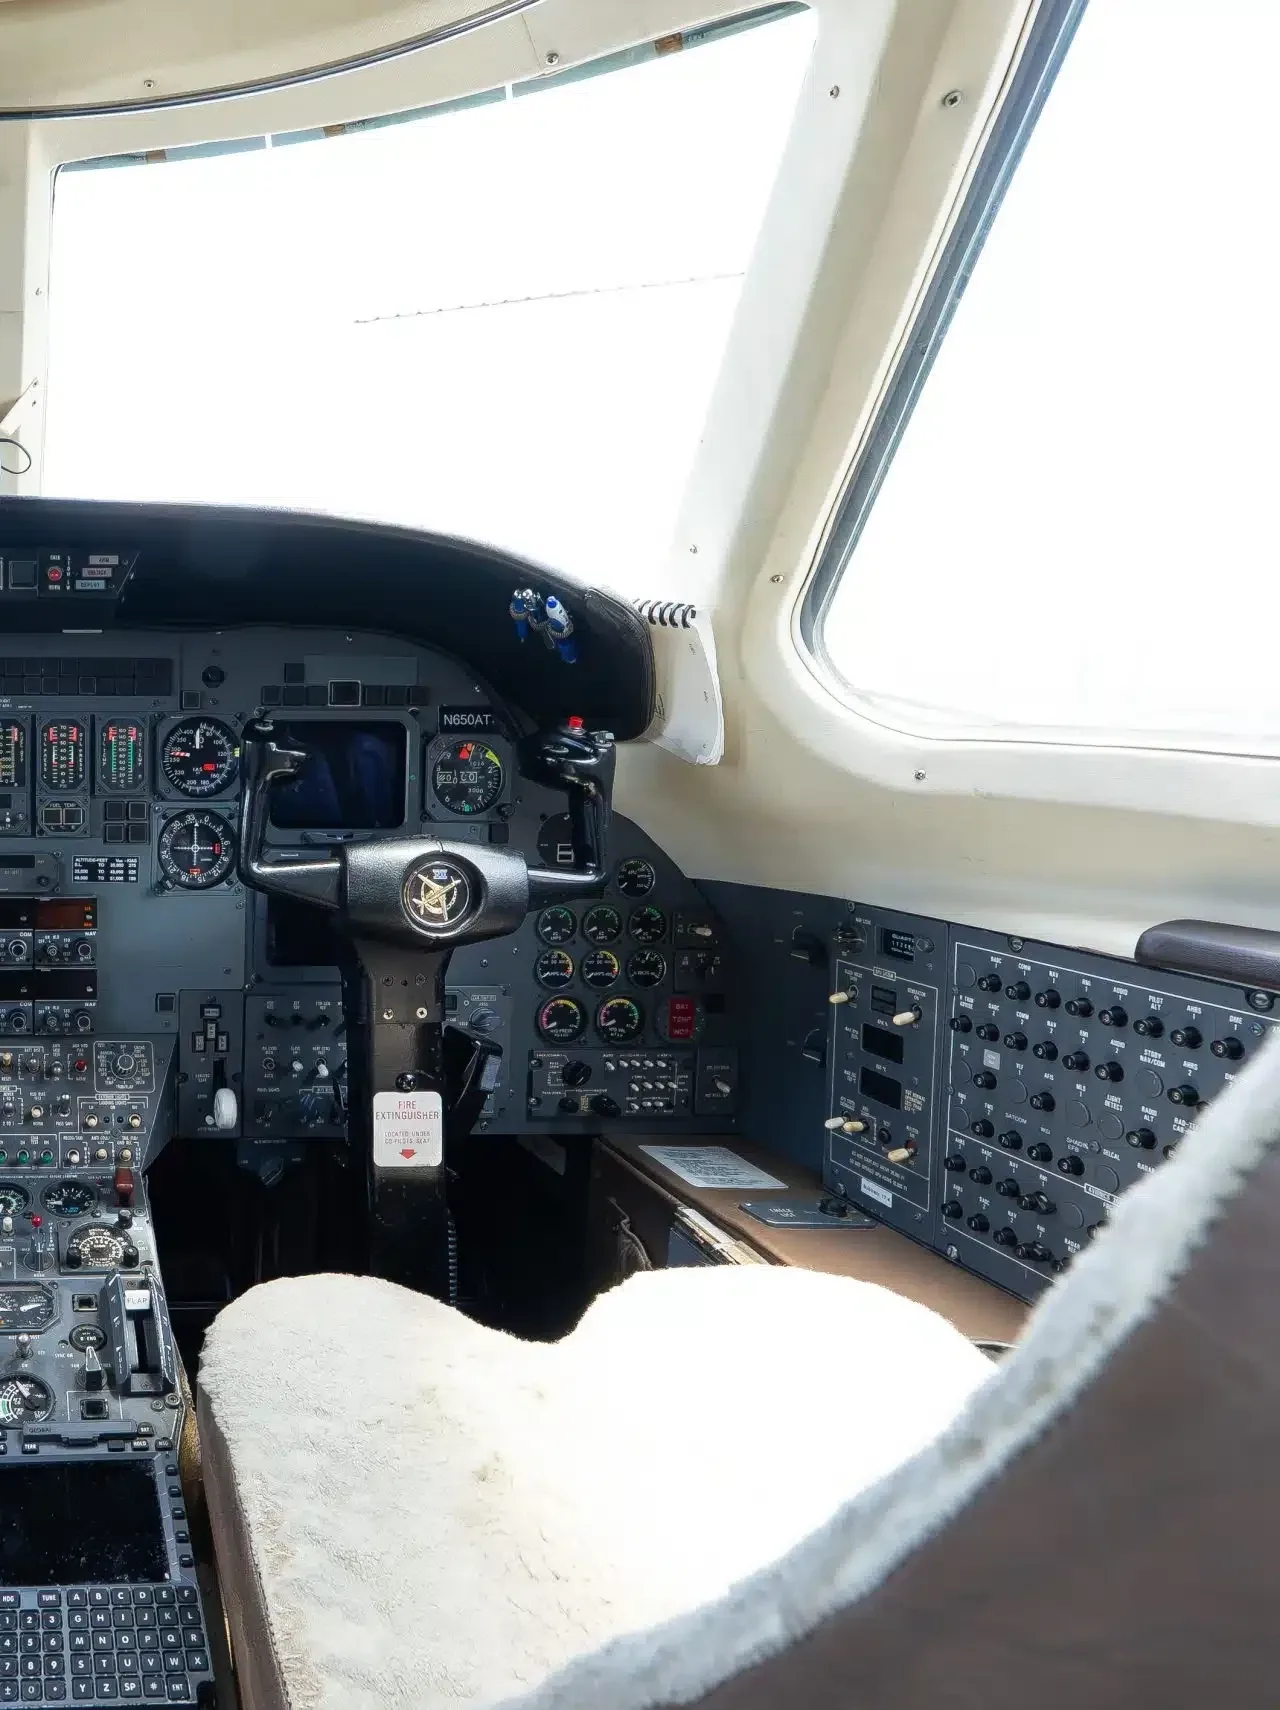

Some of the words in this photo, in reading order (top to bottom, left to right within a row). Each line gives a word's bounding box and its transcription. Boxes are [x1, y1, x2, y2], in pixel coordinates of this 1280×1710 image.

[443, 714, 492, 726] N650AT
[185, 813, 196, 822] 33
[161, 850, 168, 859] 24
[1139, 1054, 1166, 1068] NAV/COM
[398, 1100, 417, 1110] FIRE
[375, 1111, 439, 1120] EXTINGUISHER
[127, 1297, 148, 1305] FLAP
[117, 1592, 124, 1600] C
[183, 1590, 190, 1598] F
[5, 1616, 10, 1624] 1
[26, 1616, 33, 1624] 2
[74, 1615, 82, 1623] G
[96, 1614, 105, 1622] H
[143, 1613, 148, 1621] J
[164, 1612, 172, 1620] K
[187, 1611, 193, 1620] L
[27, 1638, 33, 1647] 5
[50, 1637, 56, 1646] 6
[75, 1637, 84, 1645] M
[98, 1636, 106, 1645] N
[121, 1636, 129, 1644] O
[144, 1635, 151, 1643] P
[167, 1634, 176, 1643] Q
[190, 1634, 197, 1642] R
[4, 1639, 11, 1647] 4
[27, 1661, 34, 1670] 8
[50, 1660, 57, 1669] 9
[78, 1660, 85, 1669] S
[101, 1659, 108, 1668] T
[124, 1658, 132, 1667] U
[147, 1658, 155, 1667] V
[169, 1657, 179, 1666] W
[194, 1657, 202, 1665] X
[4, 1662, 11, 1671] 7
[28, 1686, 35, 1694] 0
[79, 1683, 86, 1693] Y
[103, 1683, 110, 1692] Z
[124, 1682, 136, 1691] SP
[171, 1683, 183, 1691] ENT
